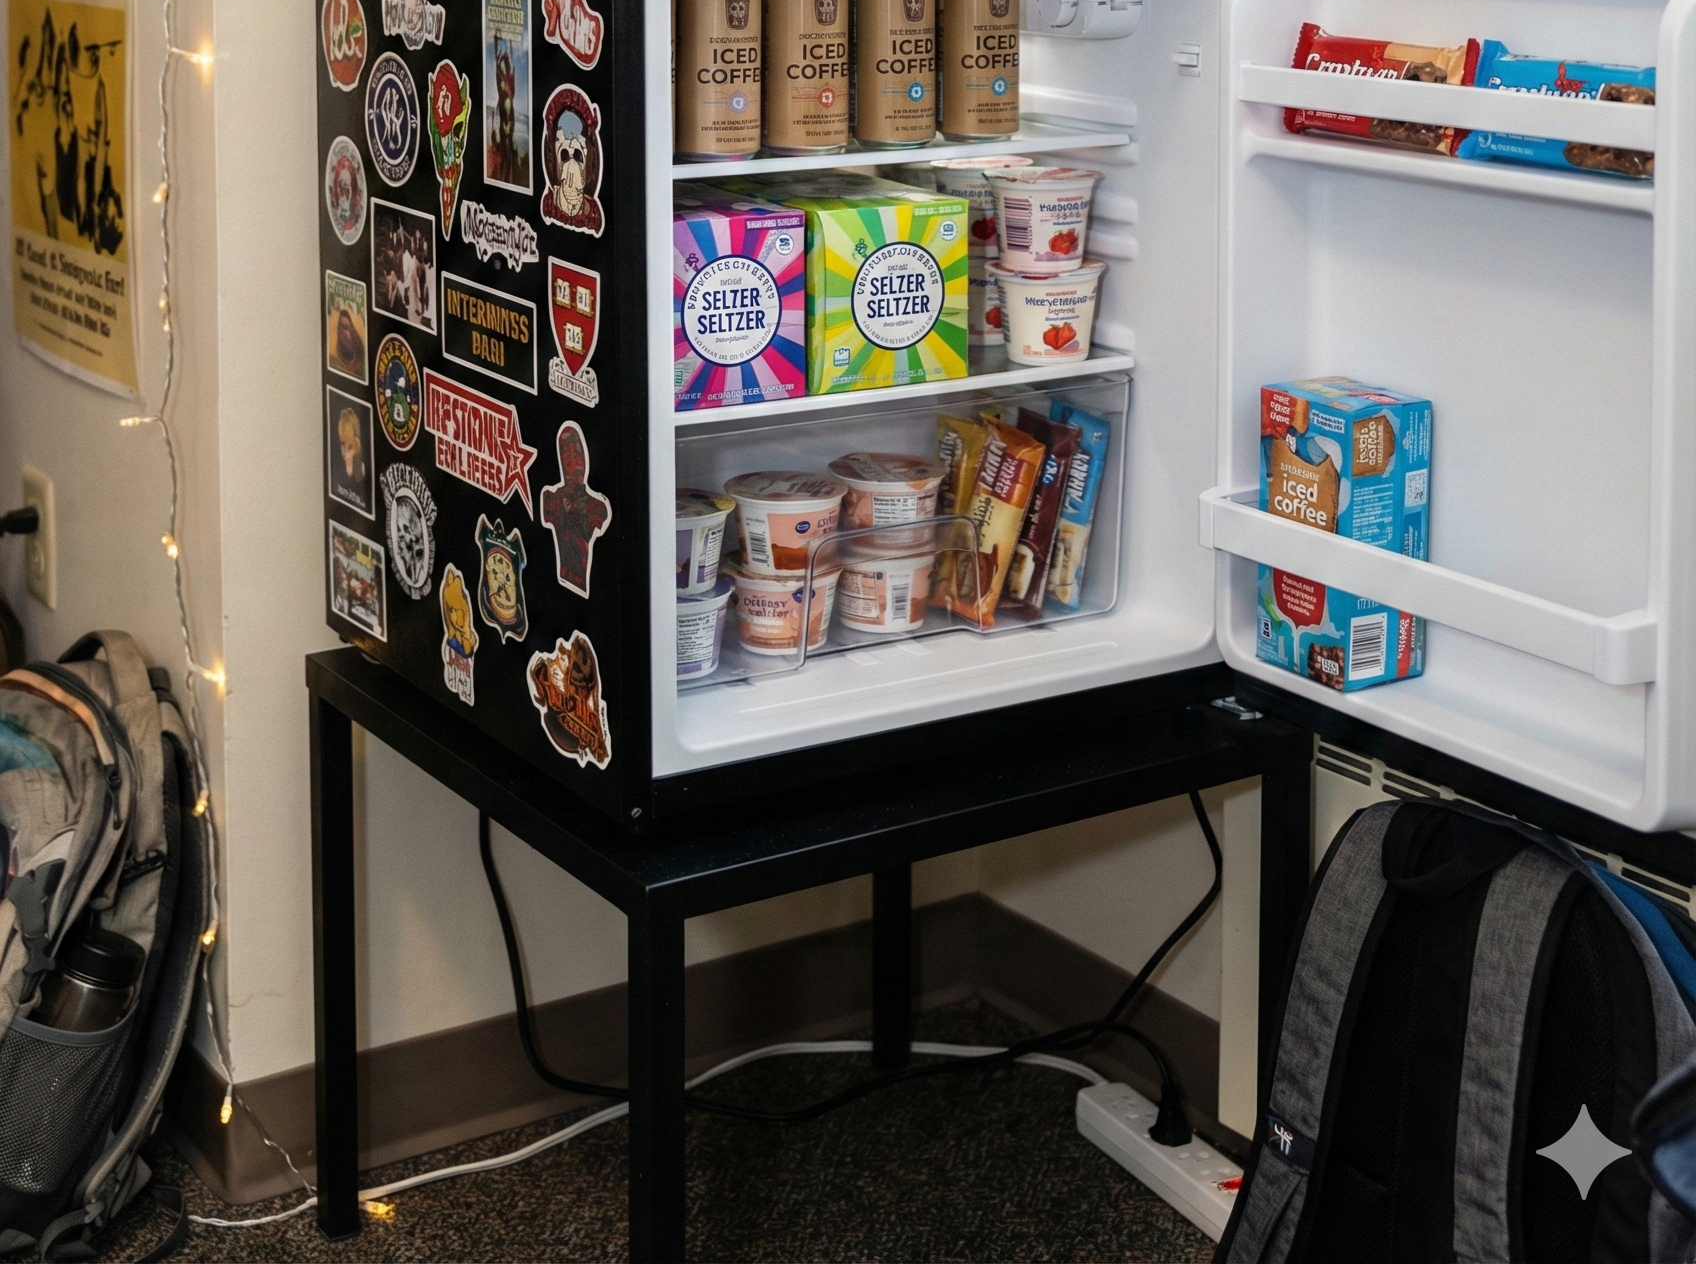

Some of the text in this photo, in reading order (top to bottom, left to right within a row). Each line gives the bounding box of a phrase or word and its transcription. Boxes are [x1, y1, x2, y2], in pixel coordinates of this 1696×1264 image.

[802, 42, 846, 61] ICED
[892, 39, 934, 56] ICED
[976, 34, 1018, 51] ICED
[713, 47, 758, 65] ICED
[867, 294, 930, 319] SELTZER
[697, 309, 766, 335] SELTZER
[1283, 473, 1318, 503] iced
[1274, 495, 1328, 526] coffee
